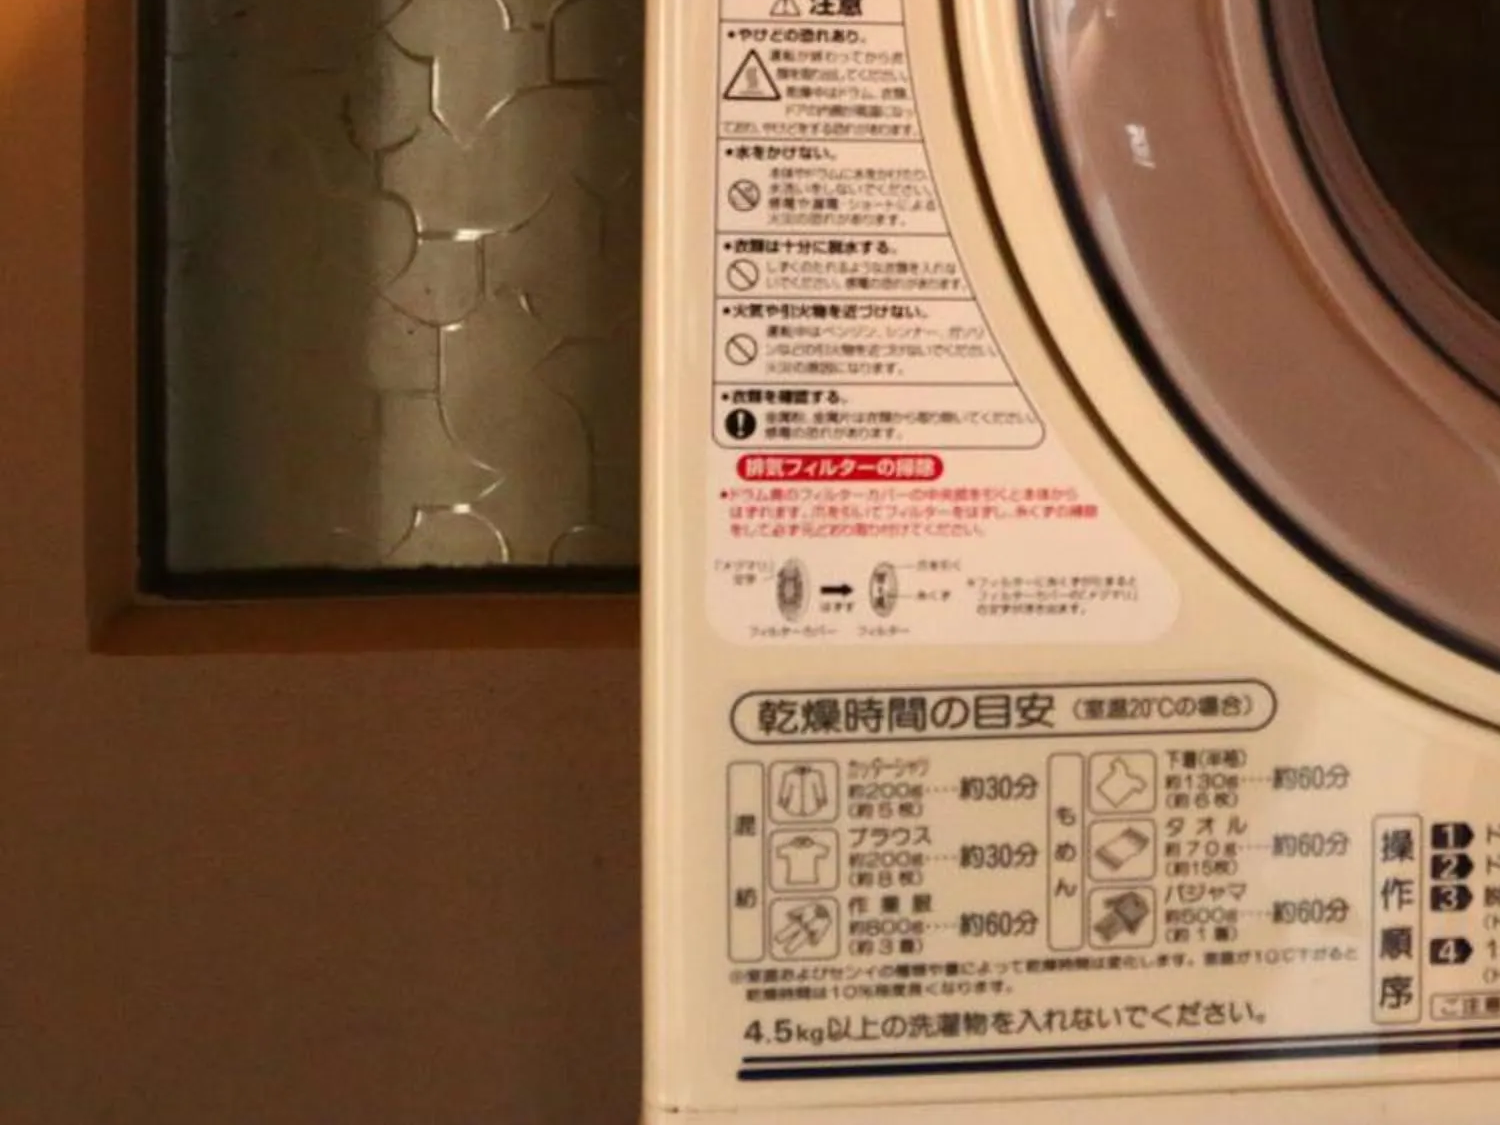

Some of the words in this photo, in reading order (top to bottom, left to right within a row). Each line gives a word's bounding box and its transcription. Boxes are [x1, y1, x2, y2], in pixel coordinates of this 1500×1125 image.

[757, 692, 1056, 736] 乾燥時間の目安
[959, 773, 1039, 802] 約30分
[849, 826, 932, 849] ブラウス
[959, 842, 1039, 870] 約30分
[1271, 830, 1351, 858] 約60分
[959, 909, 1039, 938] 約60分
[1271, 896, 1351, 925] 約60分
[1379, 828, 1416, 1012] 操作順序
